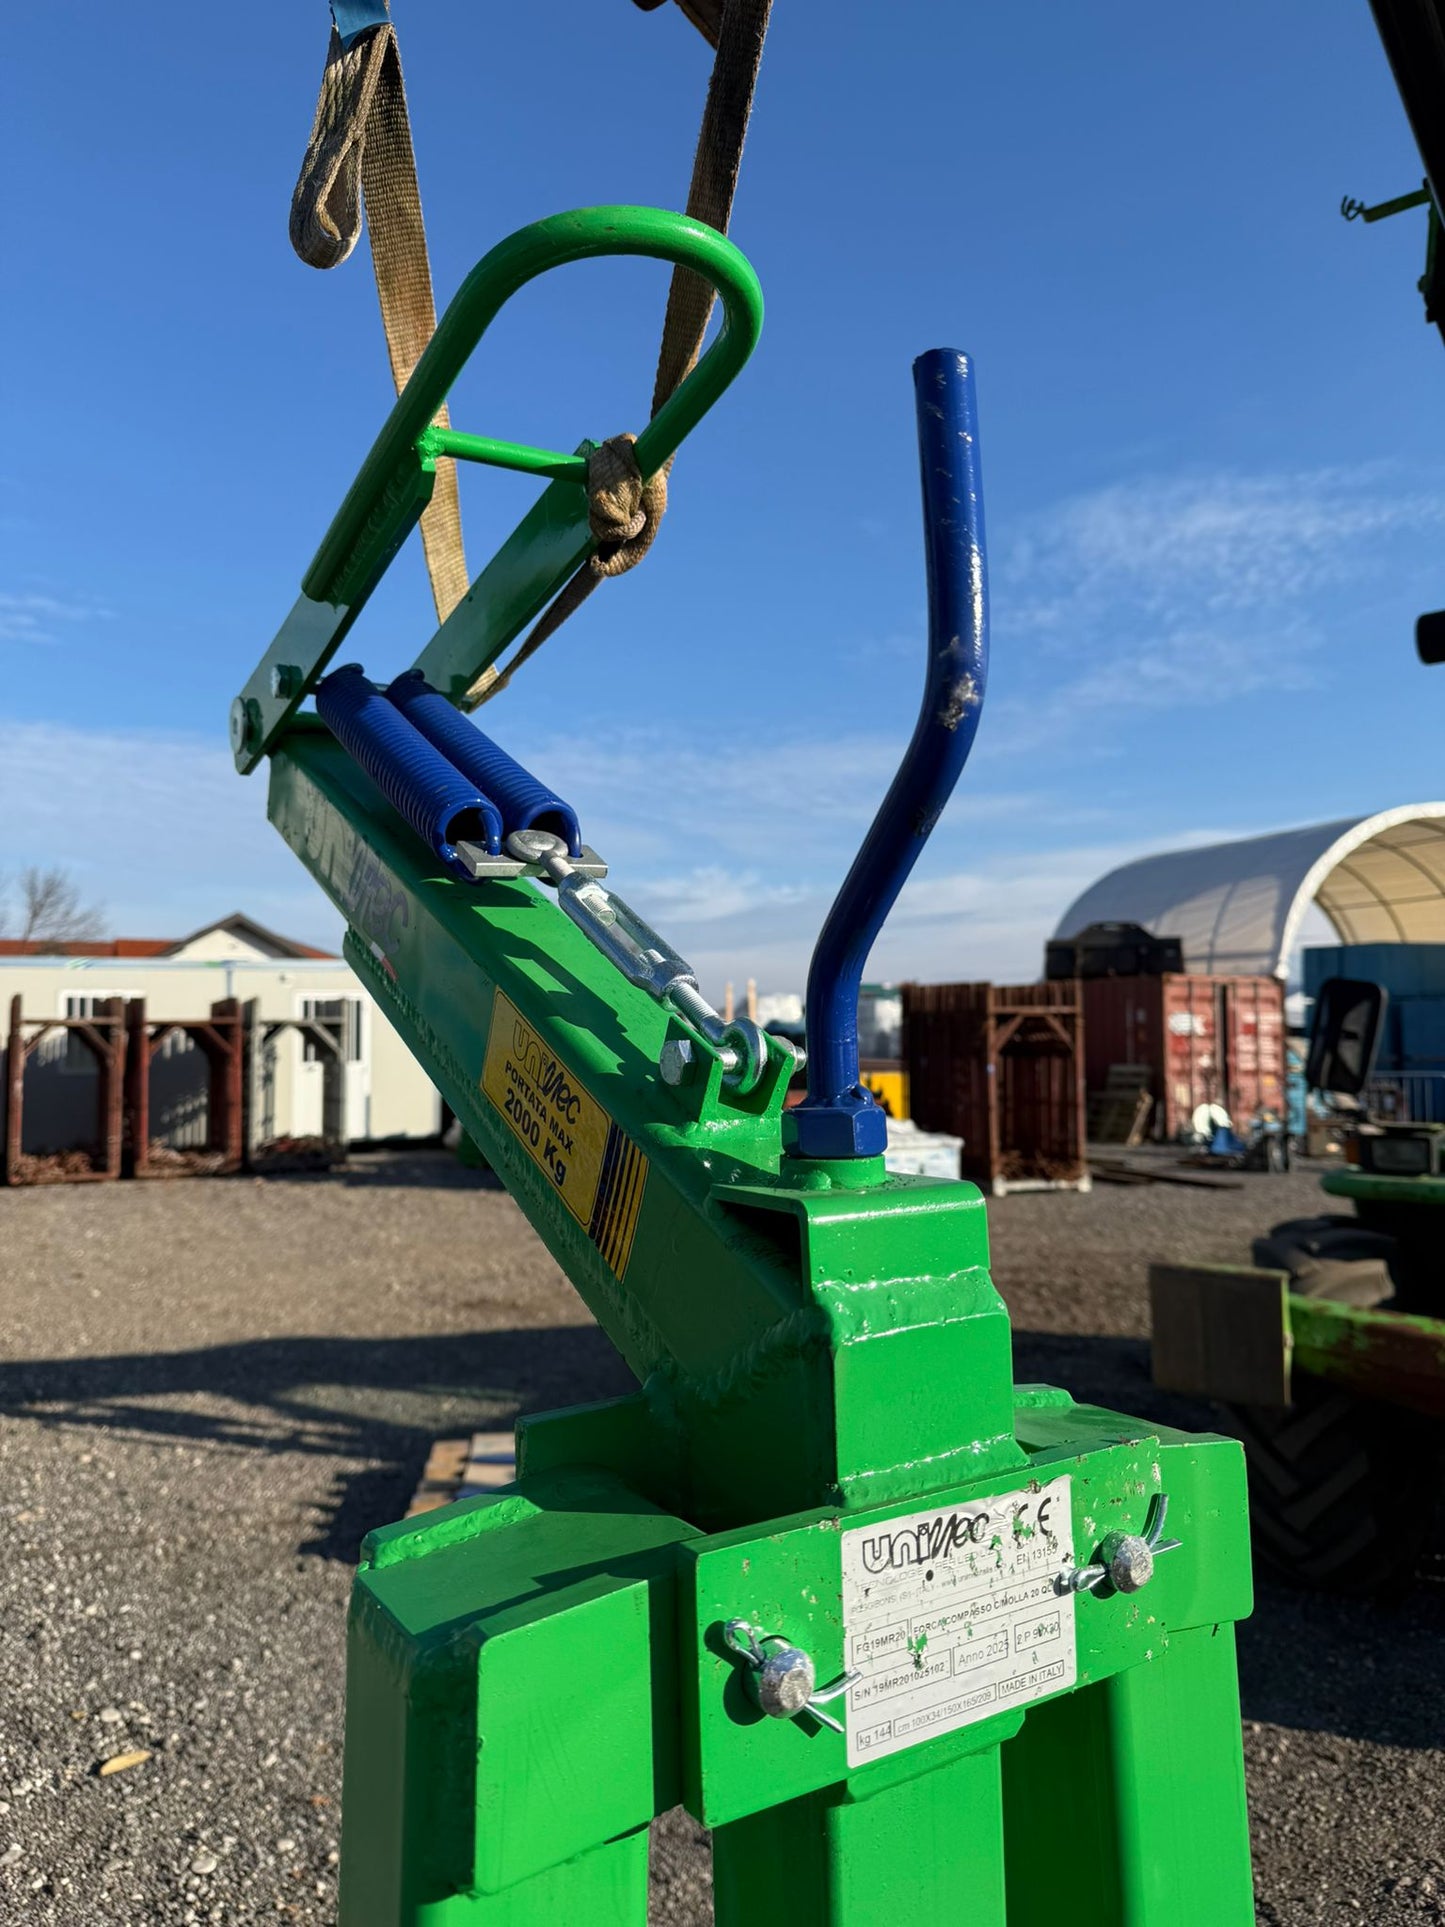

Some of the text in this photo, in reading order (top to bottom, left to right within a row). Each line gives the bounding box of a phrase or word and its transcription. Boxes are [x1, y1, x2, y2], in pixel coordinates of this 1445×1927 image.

[505, 1060, 574, 1156] PORTATA MAX
[504, 1088, 567, 1187] 2000 Kg
[945, 1602, 991, 1625] COMPASSO
[1030, 1587, 1039, 1597] 20
[855, 1631, 905, 1655] FG19MR20
[1024, 1630, 1030, 1642] P
[958, 1648, 984, 1666] Anno
[1001, 1663, 1062, 1695] MADE IN ITALY
[854, 1686, 870, 1701] S/N
[859, 1724, 890, 1748] kg 144
[898, 1722, 909, 1732] cm
